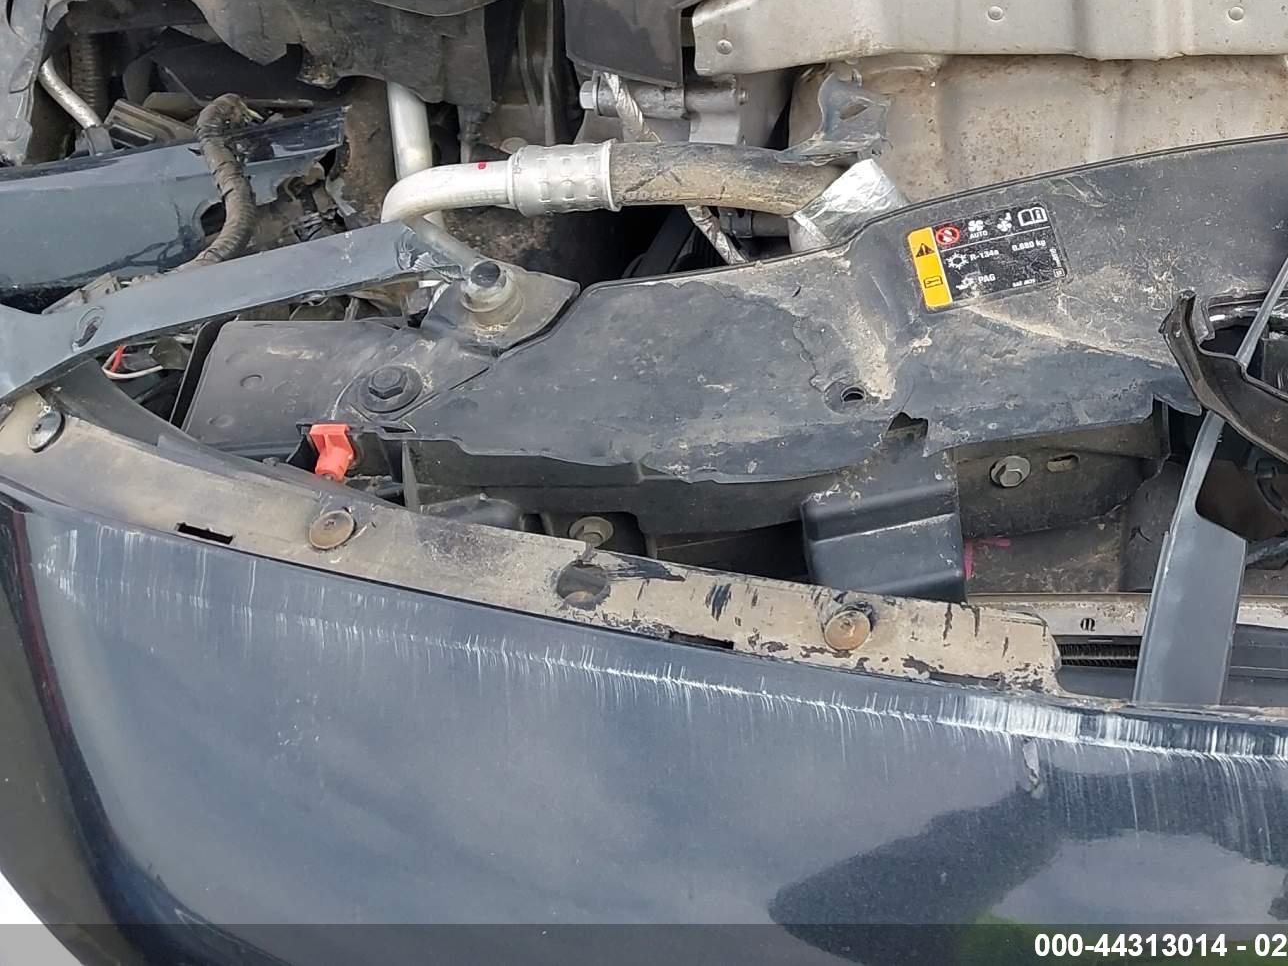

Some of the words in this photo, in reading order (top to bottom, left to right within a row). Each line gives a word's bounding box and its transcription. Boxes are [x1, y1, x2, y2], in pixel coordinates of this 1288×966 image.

[969, 231, 988, 240] AUTO
[969, 250, 999, 261] R-134a
[1036, 239, 1046, 248] kg
[978, 274, 995, 283] PAG
